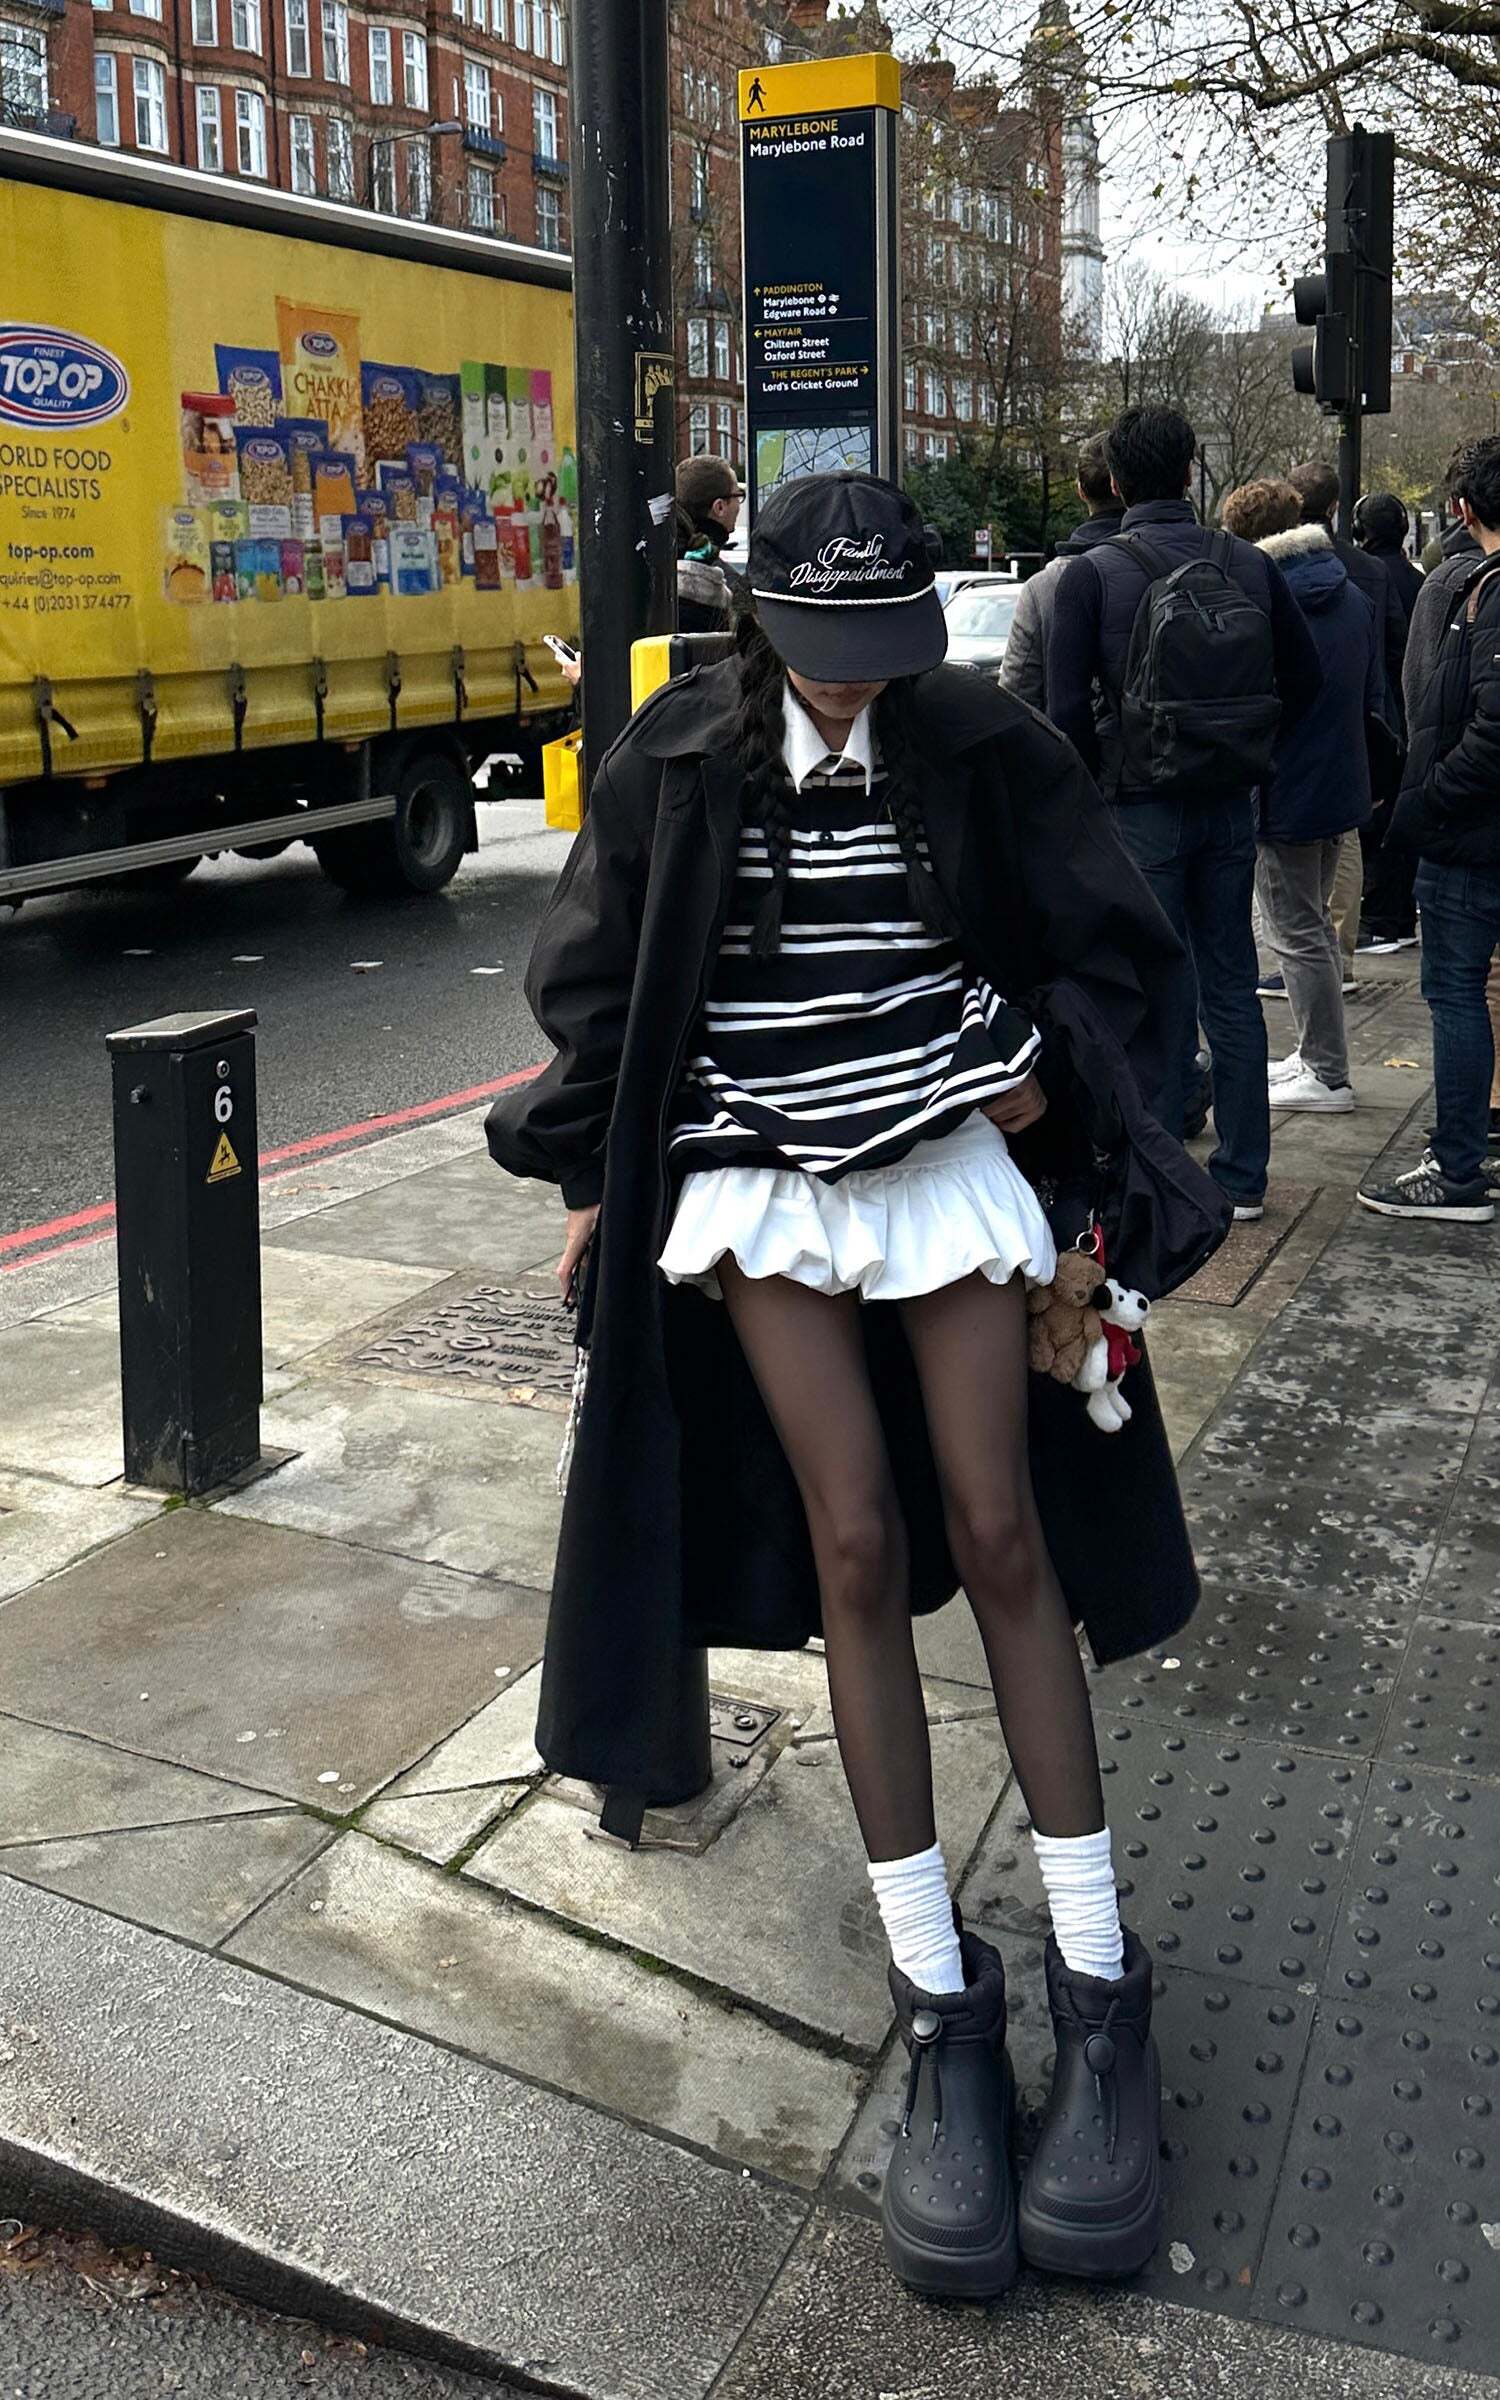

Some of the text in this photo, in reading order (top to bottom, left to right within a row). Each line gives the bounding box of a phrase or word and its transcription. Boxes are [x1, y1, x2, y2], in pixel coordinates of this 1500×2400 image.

[750, 119, 838, 139] MARYLEBONE
[750, 132, 864, 157] Marylebone Road
[763, 283, 823, 295] PADDINGTON
[763, 296, 815, 308] Marylebone
[763, 306, 826, 320] Edgware Road
[764, 327, 802, 337] MAYFAIR
[764, 337, 830, 350] Chiltern Street
[34, 346, 66, 357] FINEST
[764, 349, 826, 361] Oxford Street
[771, 366, 858, 379] THE REGENT'S PARK
[294, 373, 350, 399] CHAKKI
[762, 378, 859, 392] Lord's Cricket Ground
[33, 398, 72, 408] QUALITY
[307, 398, 341, 421] ATTA
[0, 444, 112, 471] ORLD FOOD
[22, 505, 76, 520] Since 1974
[8, 543, 94, 563] top-op.com
[817, 534, 884, 569] Family
[0, 569, 121, 590] quiries@top-op.com
[790, 559, 913, 593] Disappointment
[2, 597, 29, 610] +44
[215, 1085, 233, 1122] 6
